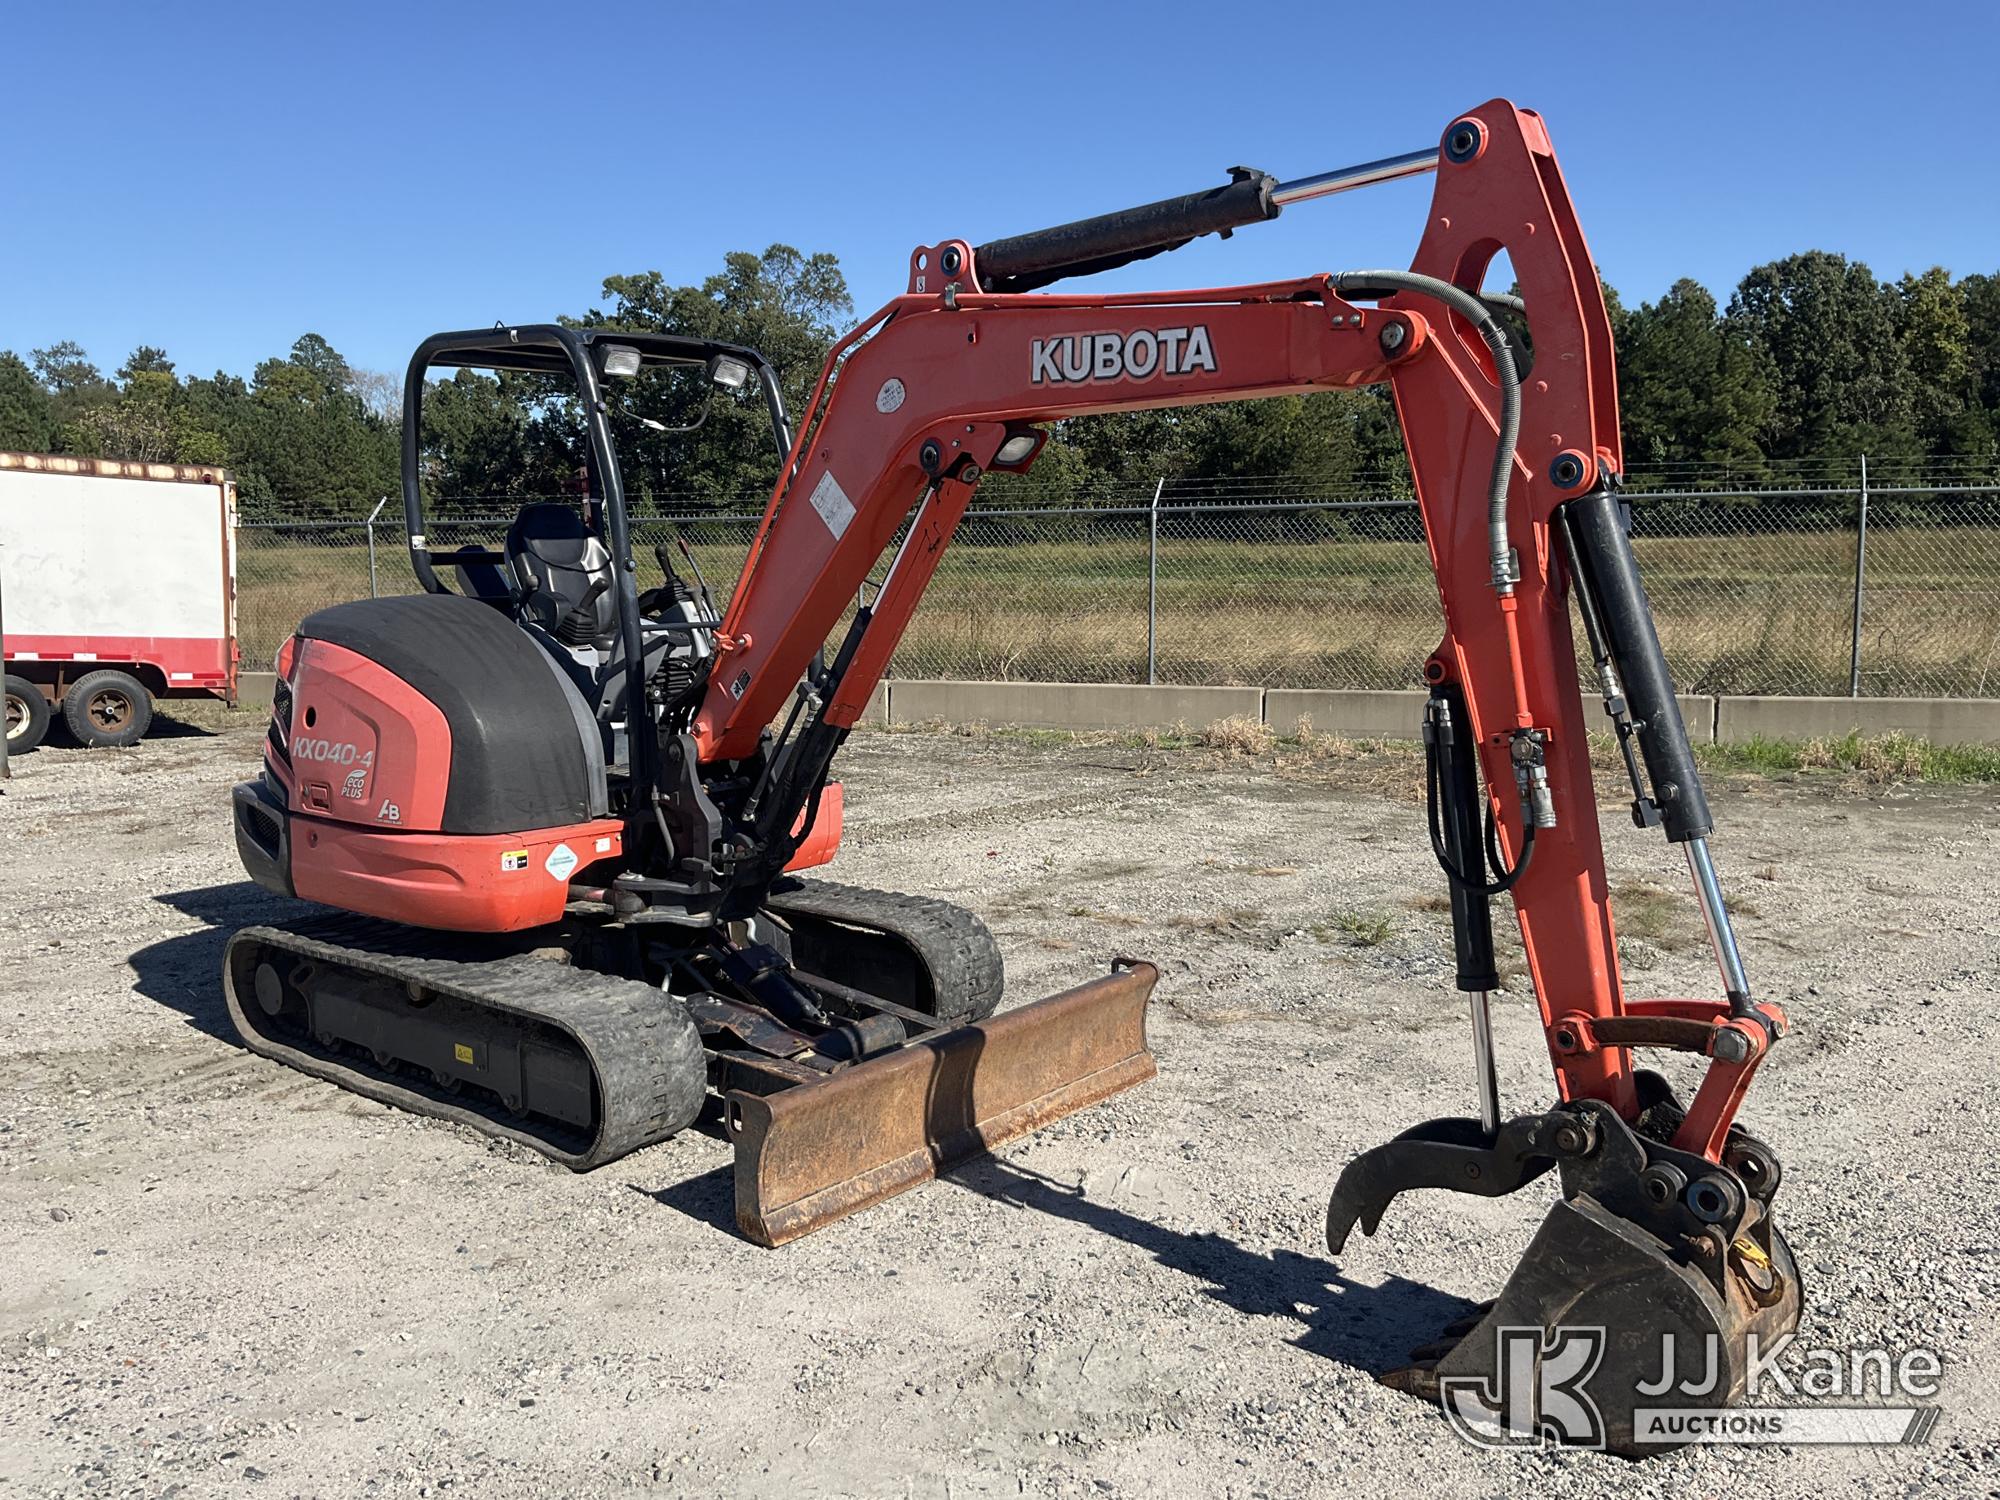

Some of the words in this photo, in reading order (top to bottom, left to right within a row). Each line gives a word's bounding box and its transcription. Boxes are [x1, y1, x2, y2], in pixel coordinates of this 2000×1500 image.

[1031, 325, 1217, 384] KUBOTA
[292, 736, 374, 768] KX040-4
[341, 786, 363, 799] PLUS
[347, 777, 365, 788] eco
